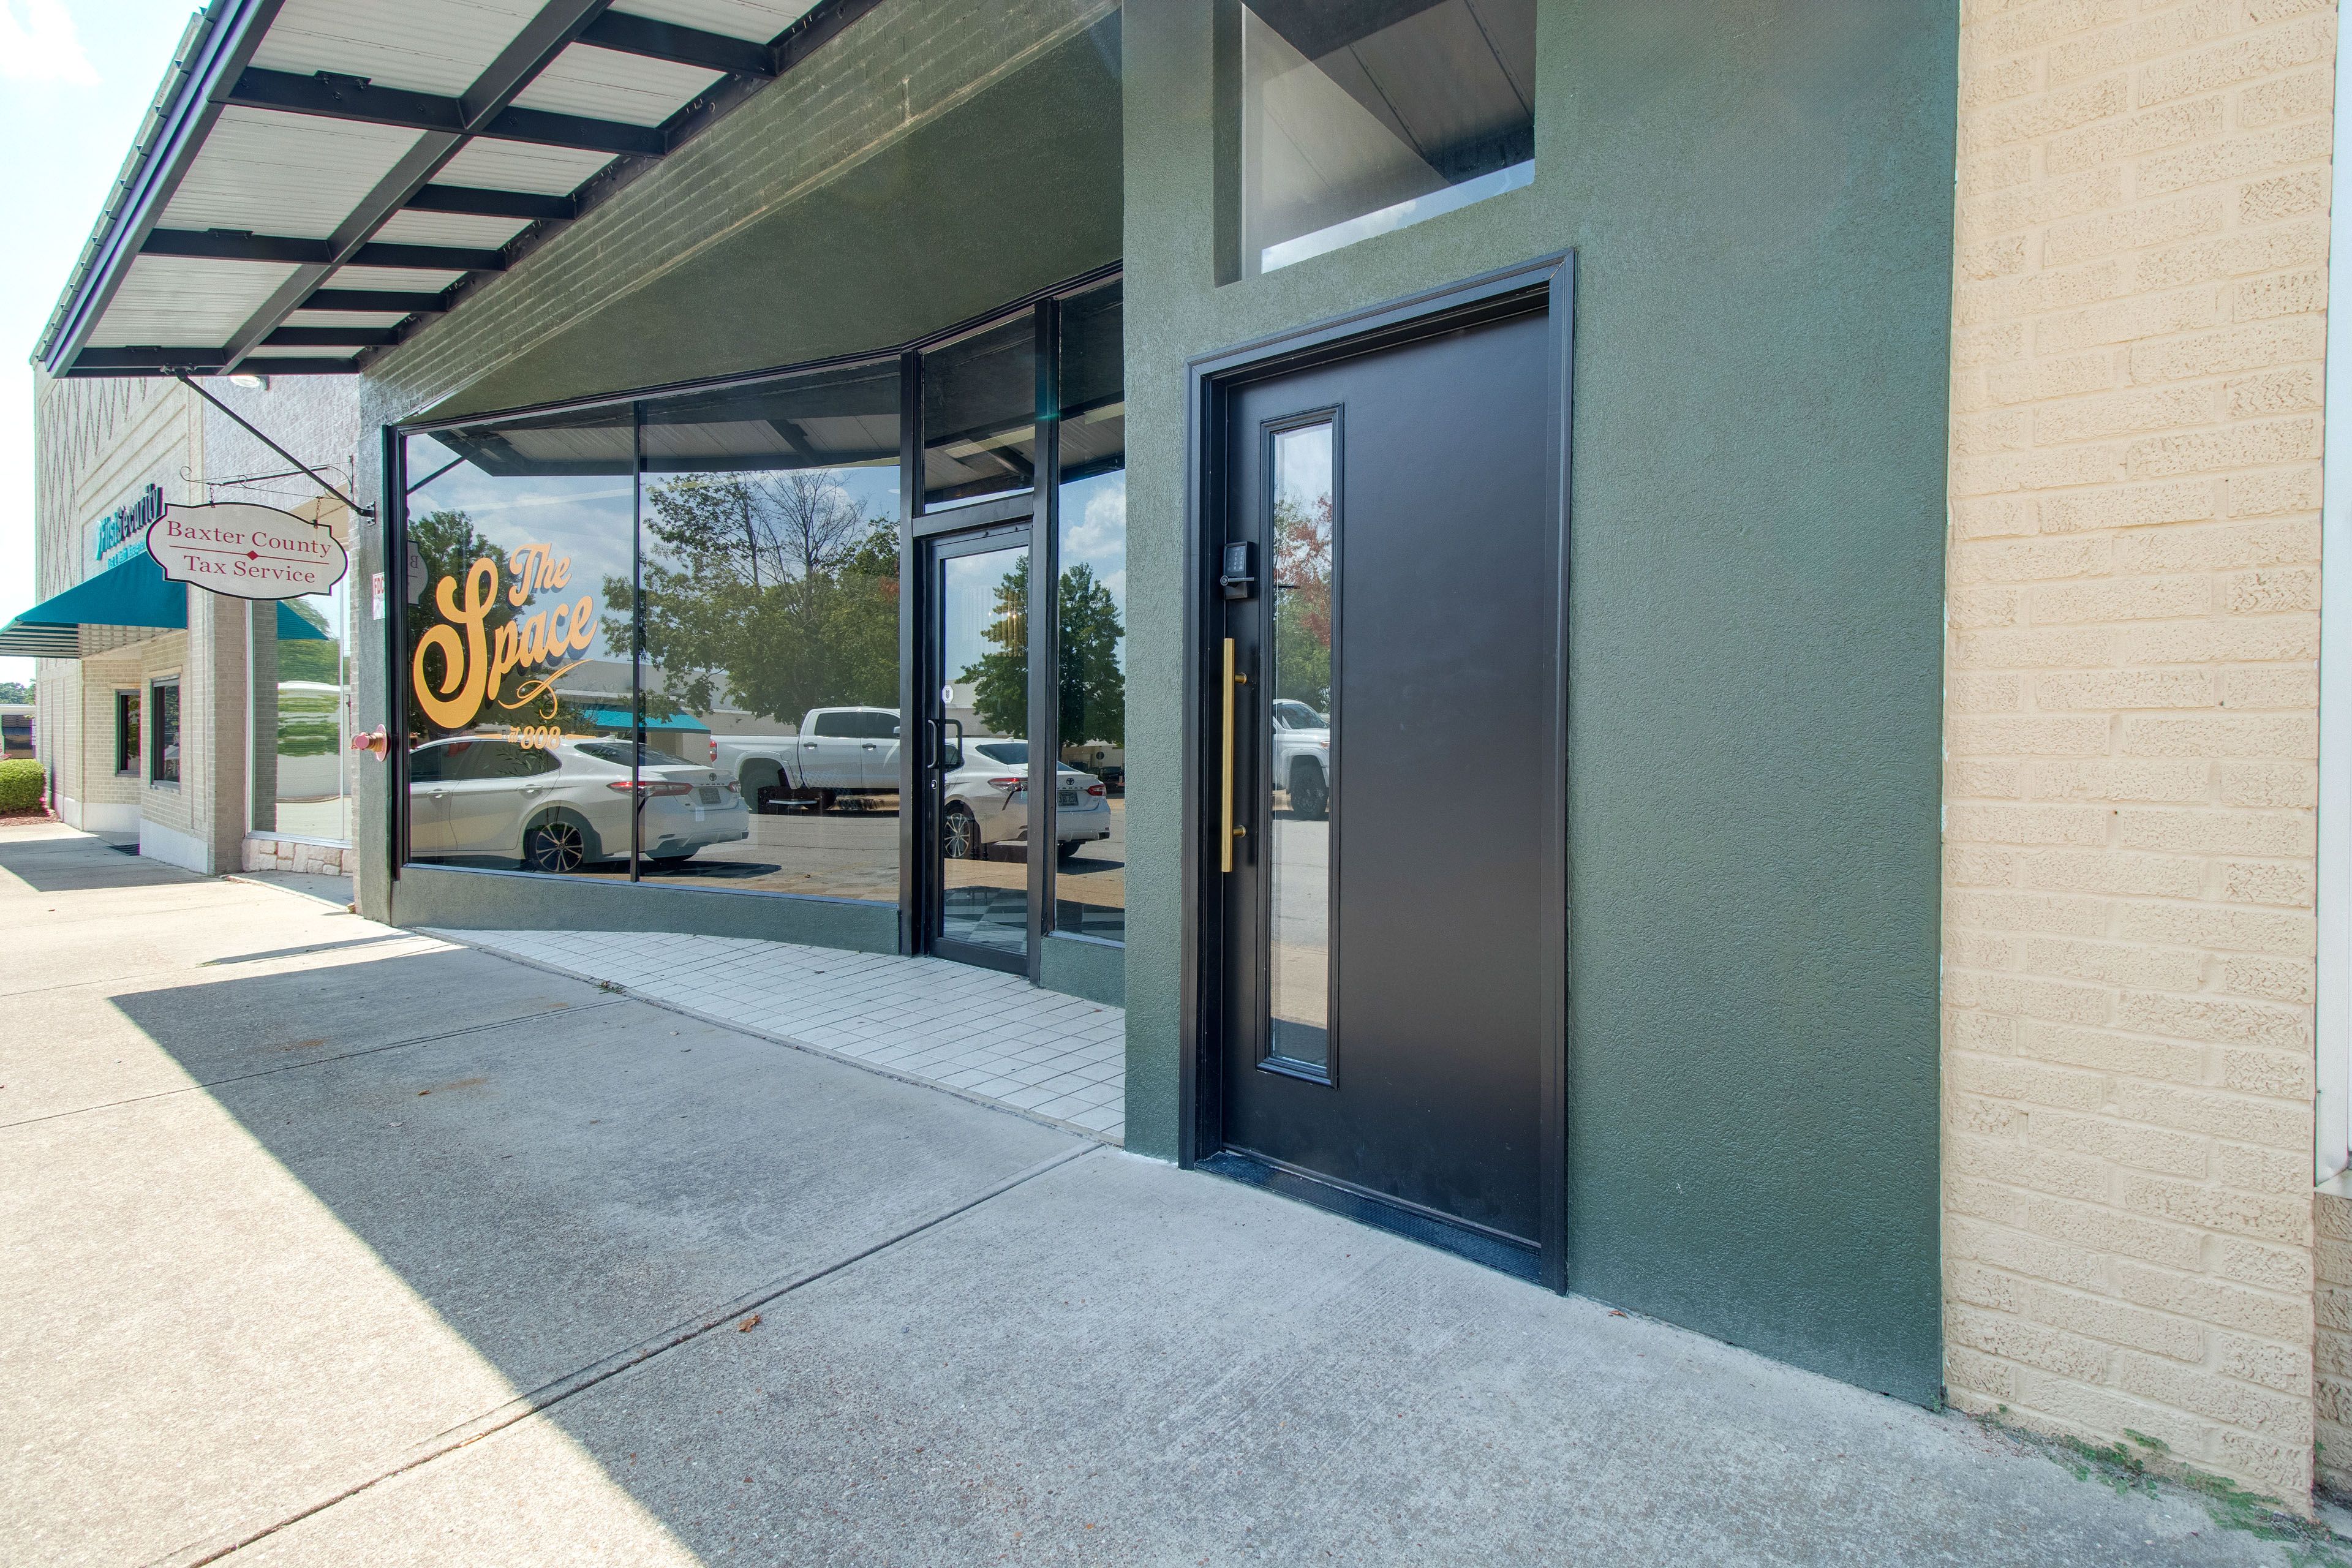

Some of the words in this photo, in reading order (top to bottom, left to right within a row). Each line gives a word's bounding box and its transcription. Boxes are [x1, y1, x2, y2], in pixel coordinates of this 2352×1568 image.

[117, 483, 164, 541] Security
[167, 520, 245, 545] Baxter
[251, 532, 332, 558] County
[184, 555, 227, 575] Tax
[233, 560, 316, 583] Service
[508, 542, 571, 607] The
[413, 557, 598, 729] Space
[521, 725, 562, 750] 808
